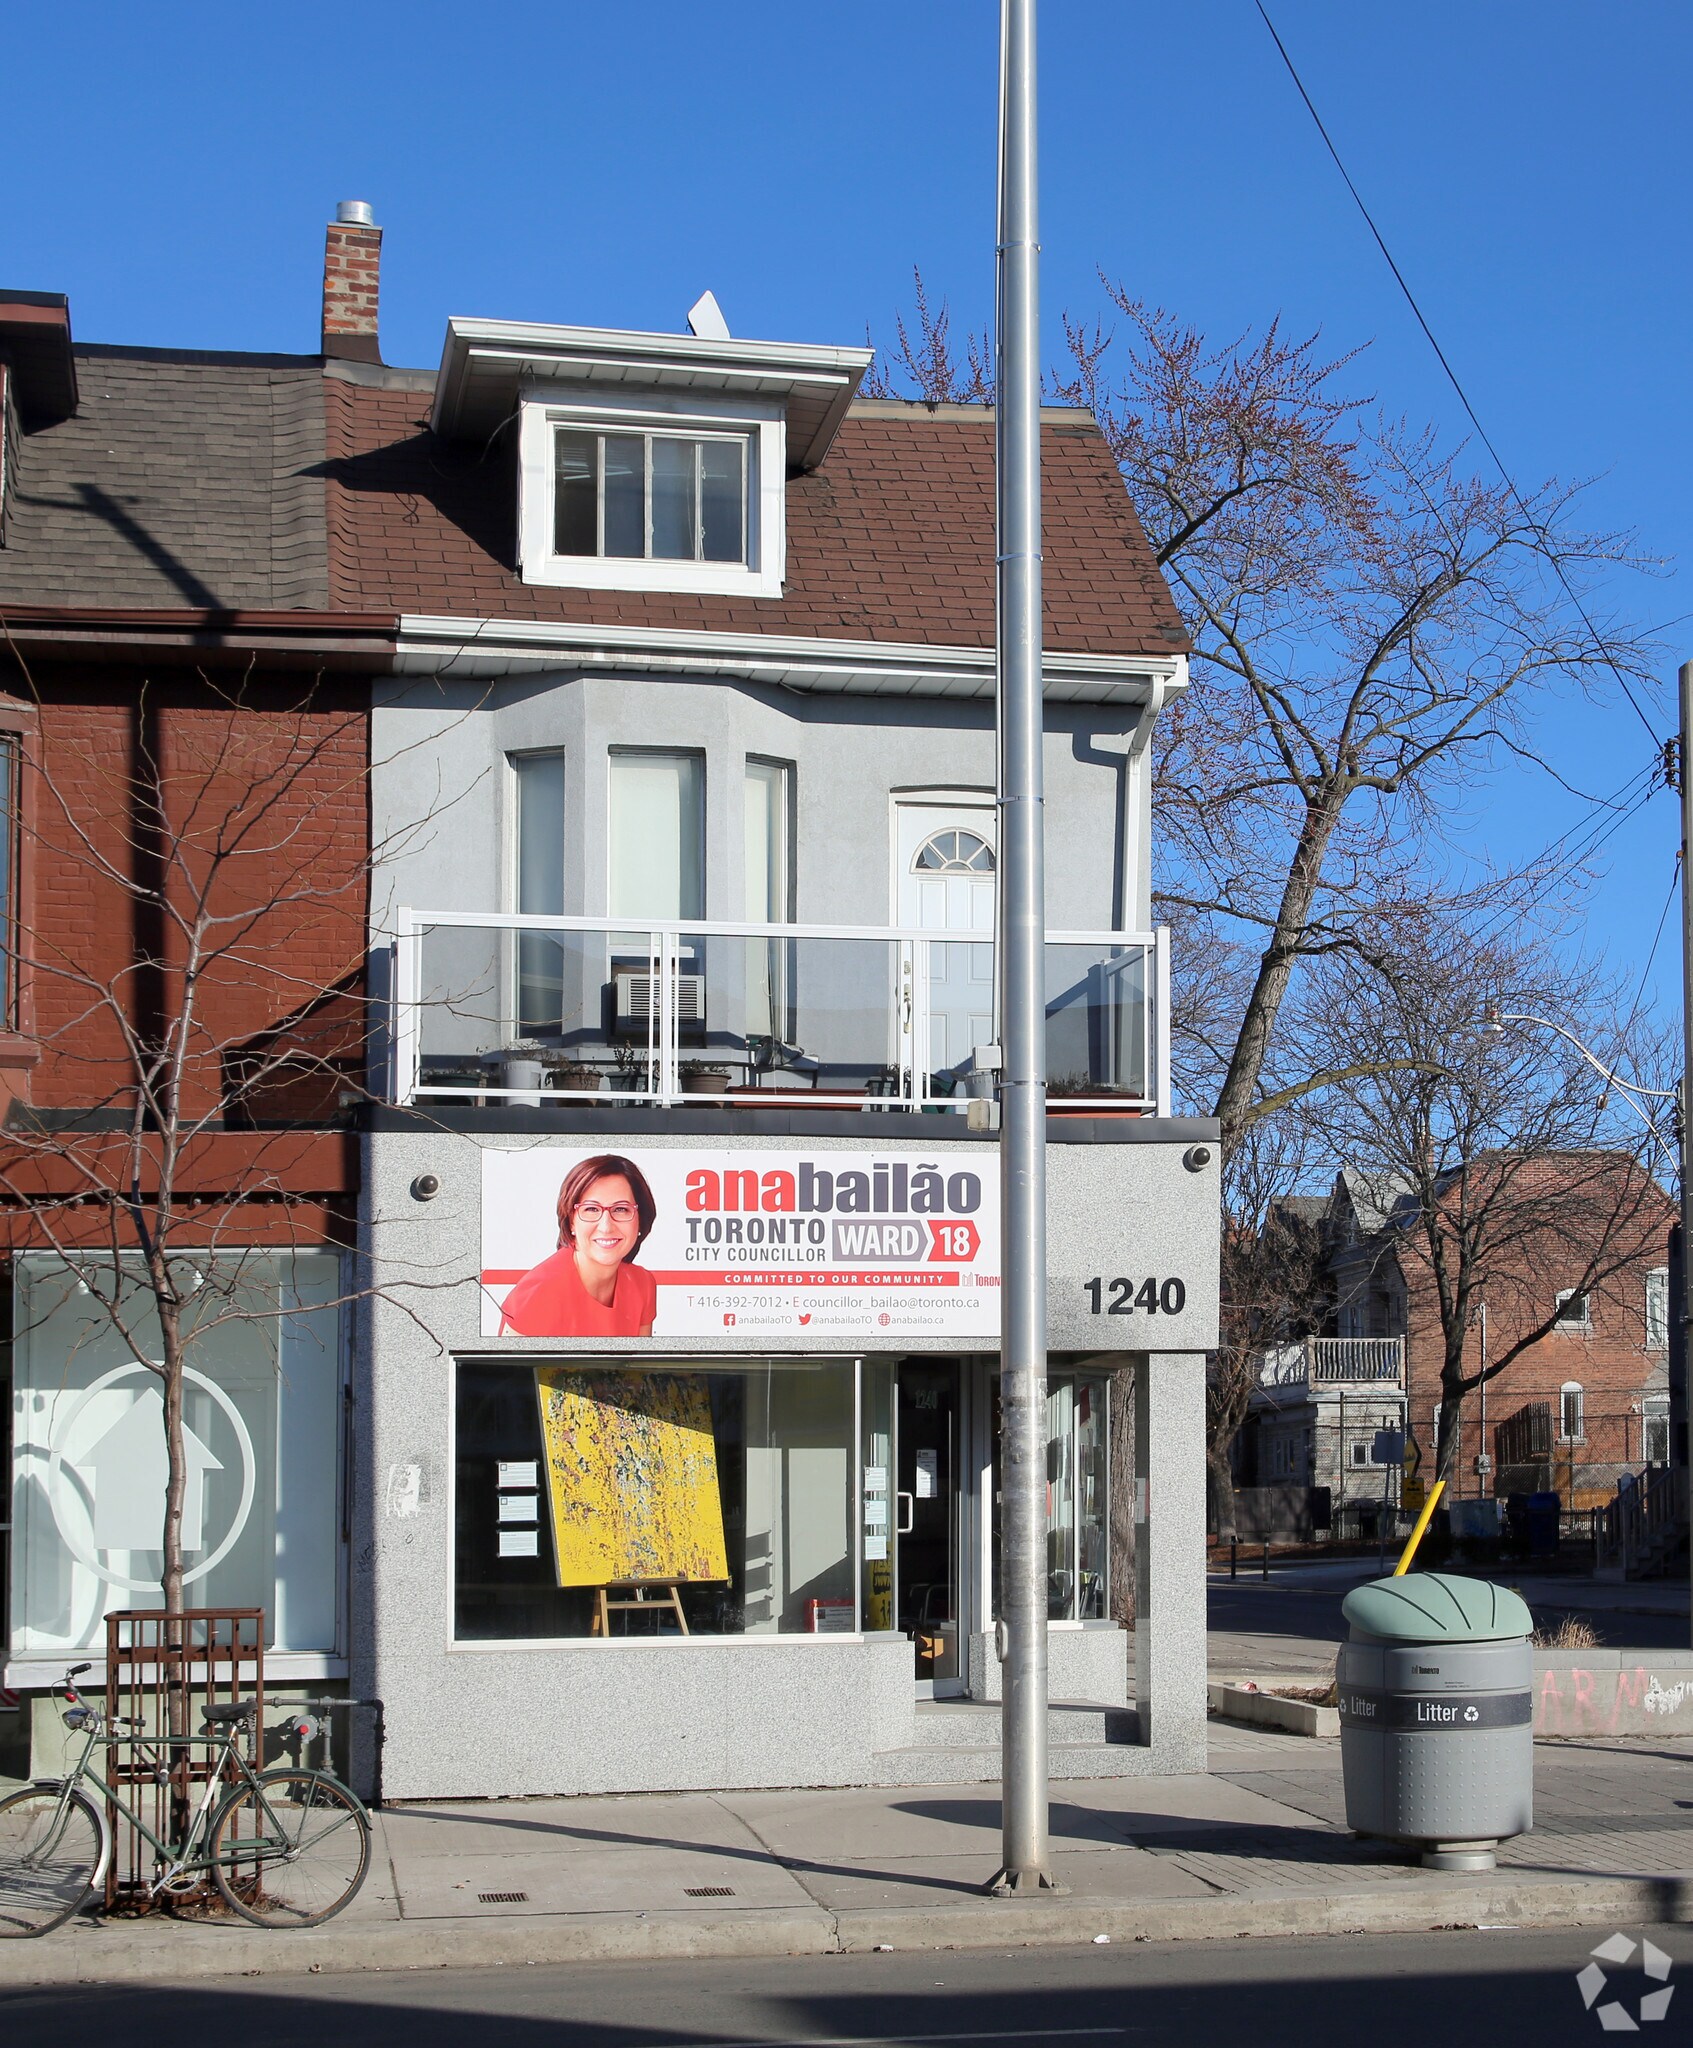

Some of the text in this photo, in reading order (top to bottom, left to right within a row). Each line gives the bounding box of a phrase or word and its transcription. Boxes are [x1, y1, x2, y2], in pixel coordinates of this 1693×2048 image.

[685, 1162, 981, 1213] anabailão
[685, 1217, 825, 1245] TORONTO
[837, 1225, 971, 1256] WARD 18
[685, 1247, 826, 1262] CITY COUNCILLOR
[724, 1274, 944, 1284] COMMITTED TO OUR COMMUNITY
[687, 1296, 980, 1310] T 416-392-7012 E councillor_bailao@toronto.ca
[1083, 1277, 1186, 1315] 1240
[738, 1315, 792, 1325] anabailaoTO
[811, 1315, 873, 1326] @anabailaoTO
[891, 1315, 944, 1325] anabailao.ca
[1351, 1696, 1377, 1717] Litter
[1417, 1703, 1459, 1722] Litter
